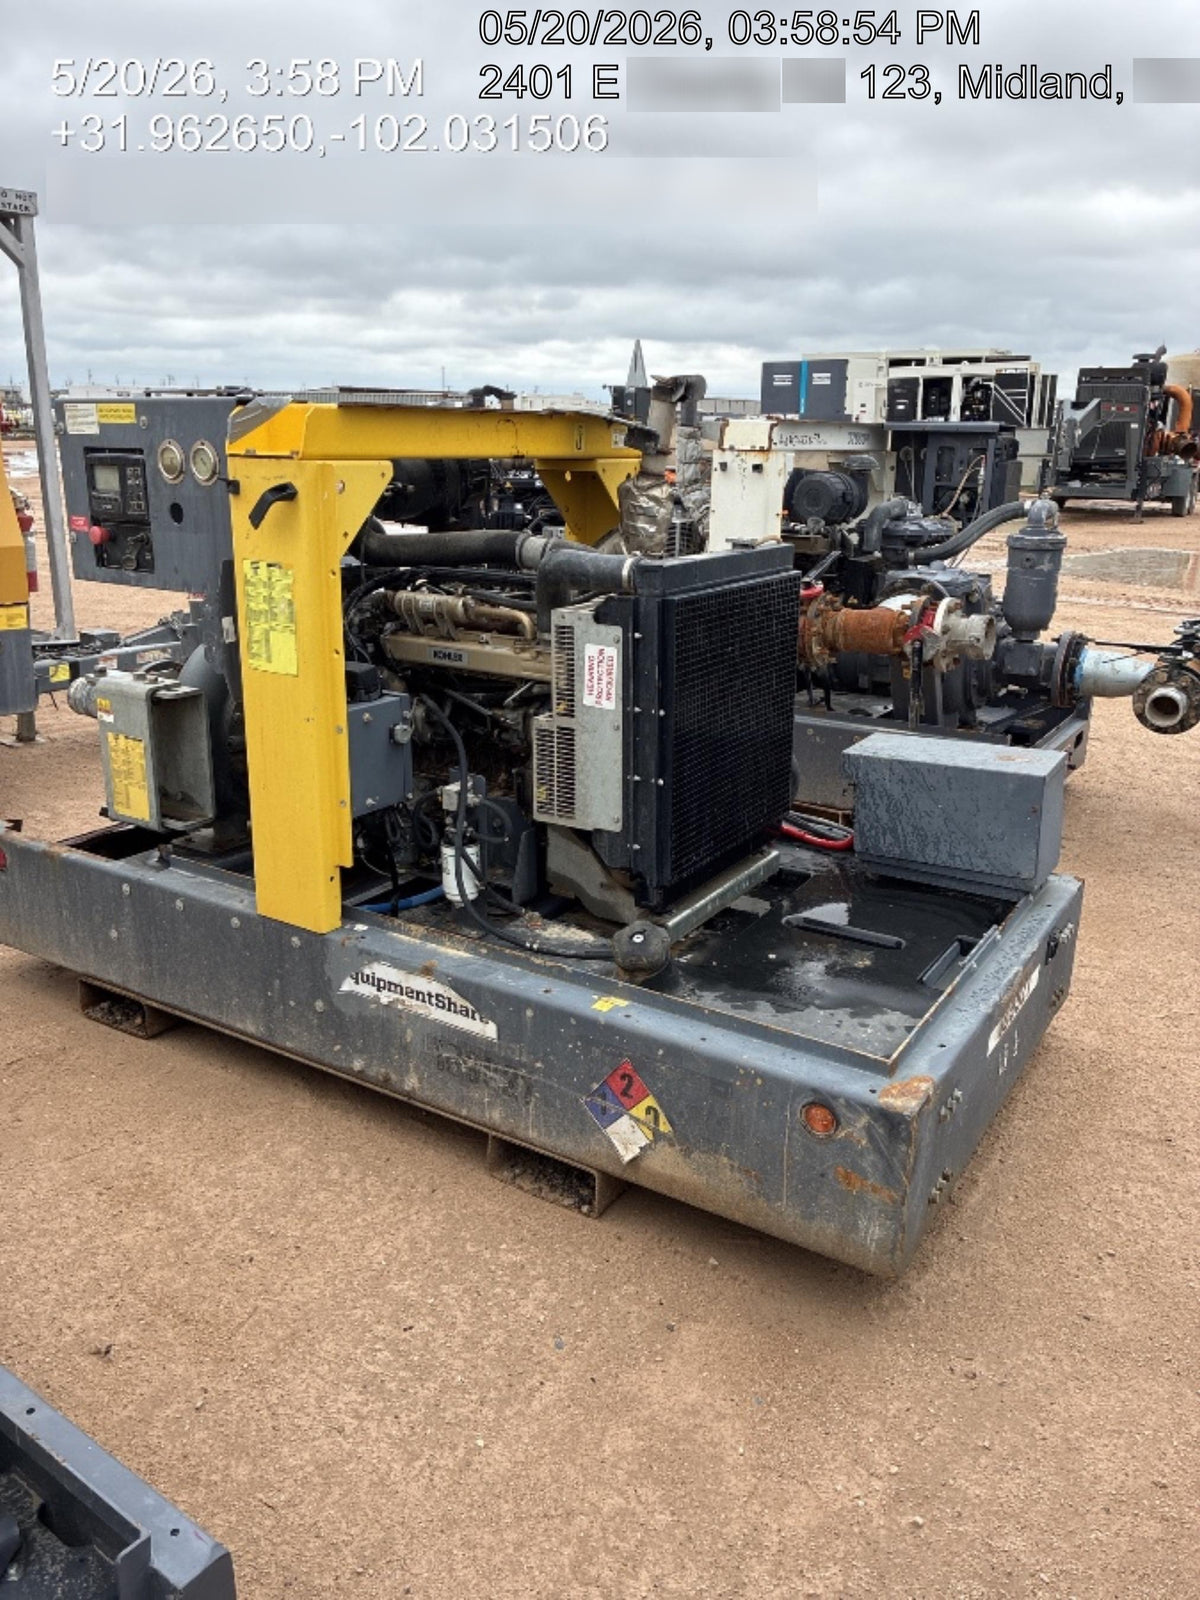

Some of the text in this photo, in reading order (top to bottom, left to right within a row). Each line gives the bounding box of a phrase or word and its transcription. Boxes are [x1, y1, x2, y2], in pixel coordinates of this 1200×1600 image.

[433, 649, 463, 662] KOHLER
[586, 655, 596, 696] HEARING
[349, 971, 490, 1025] quipmentShar
[619, 1072, 634, 1099] 2
